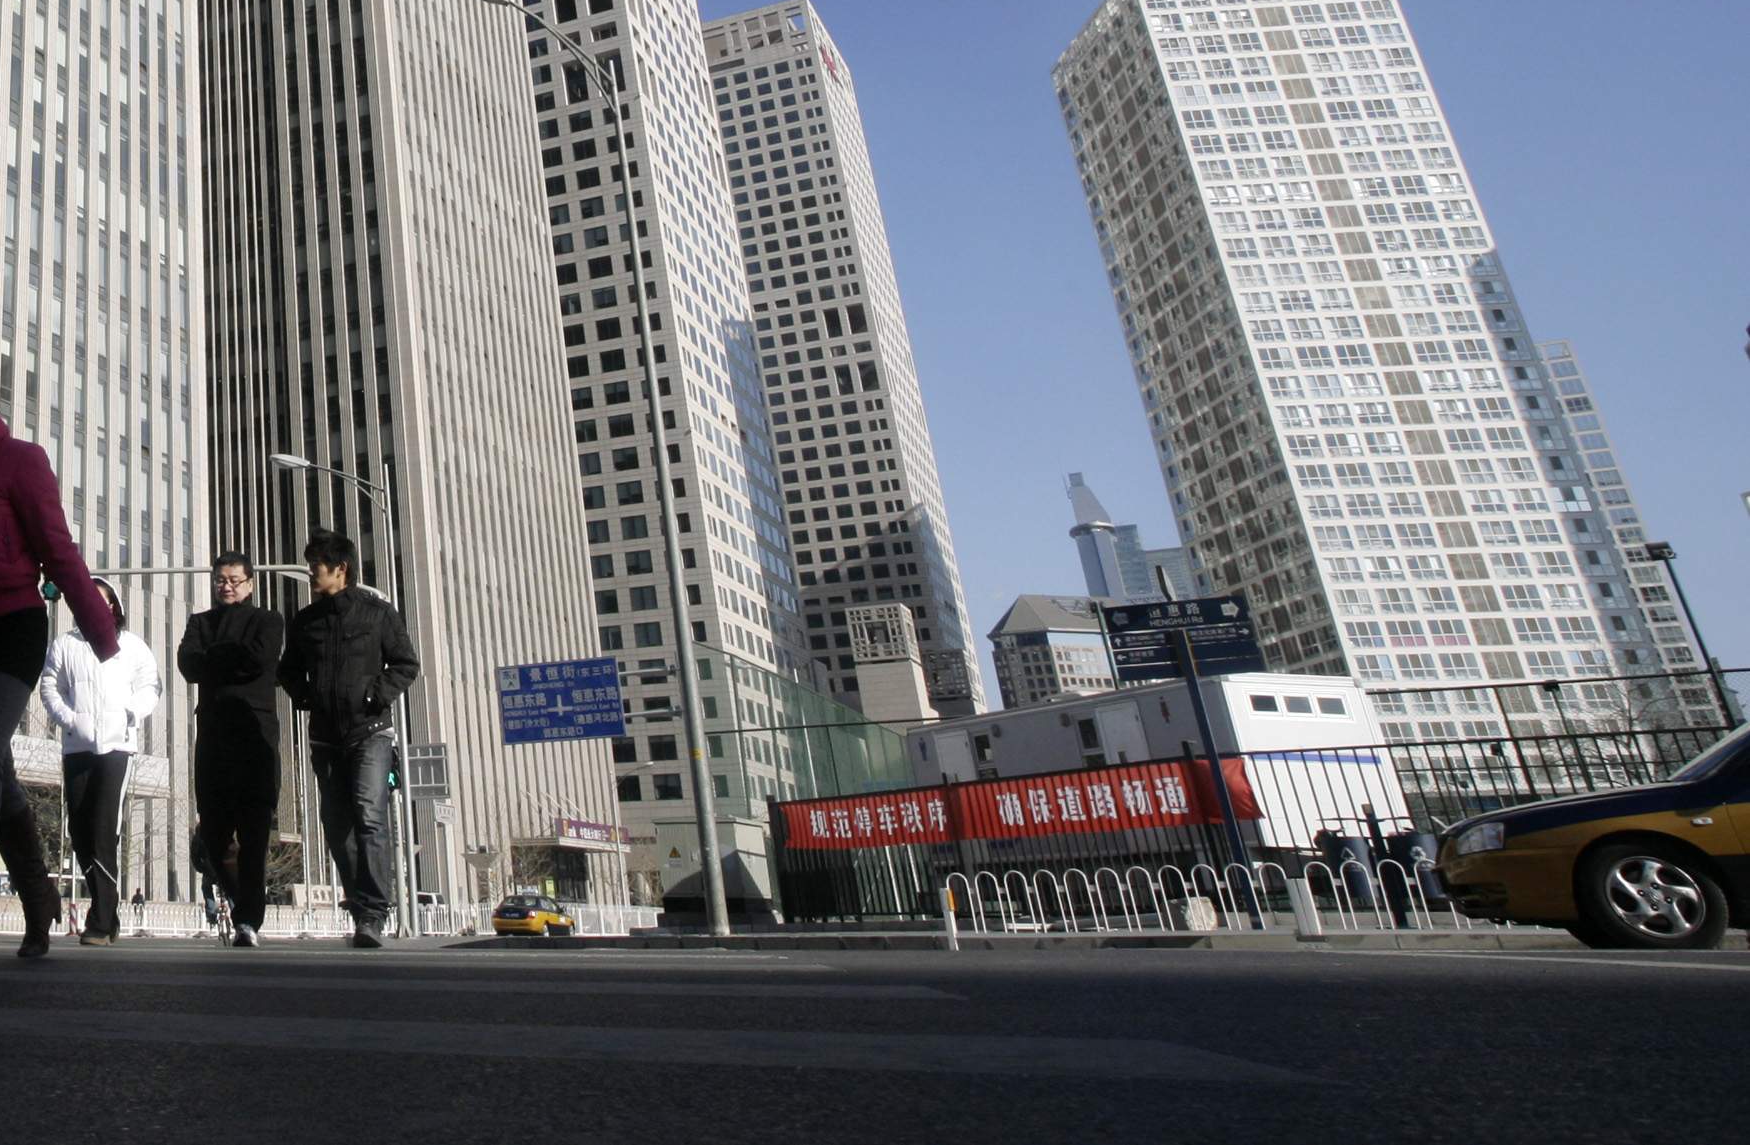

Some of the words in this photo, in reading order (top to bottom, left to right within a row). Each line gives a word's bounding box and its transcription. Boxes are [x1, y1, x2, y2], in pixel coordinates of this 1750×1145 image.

[809, 798, 947, 839] 规范停车秩序
[995, 776, 1189, 826] 确保道路畅通
